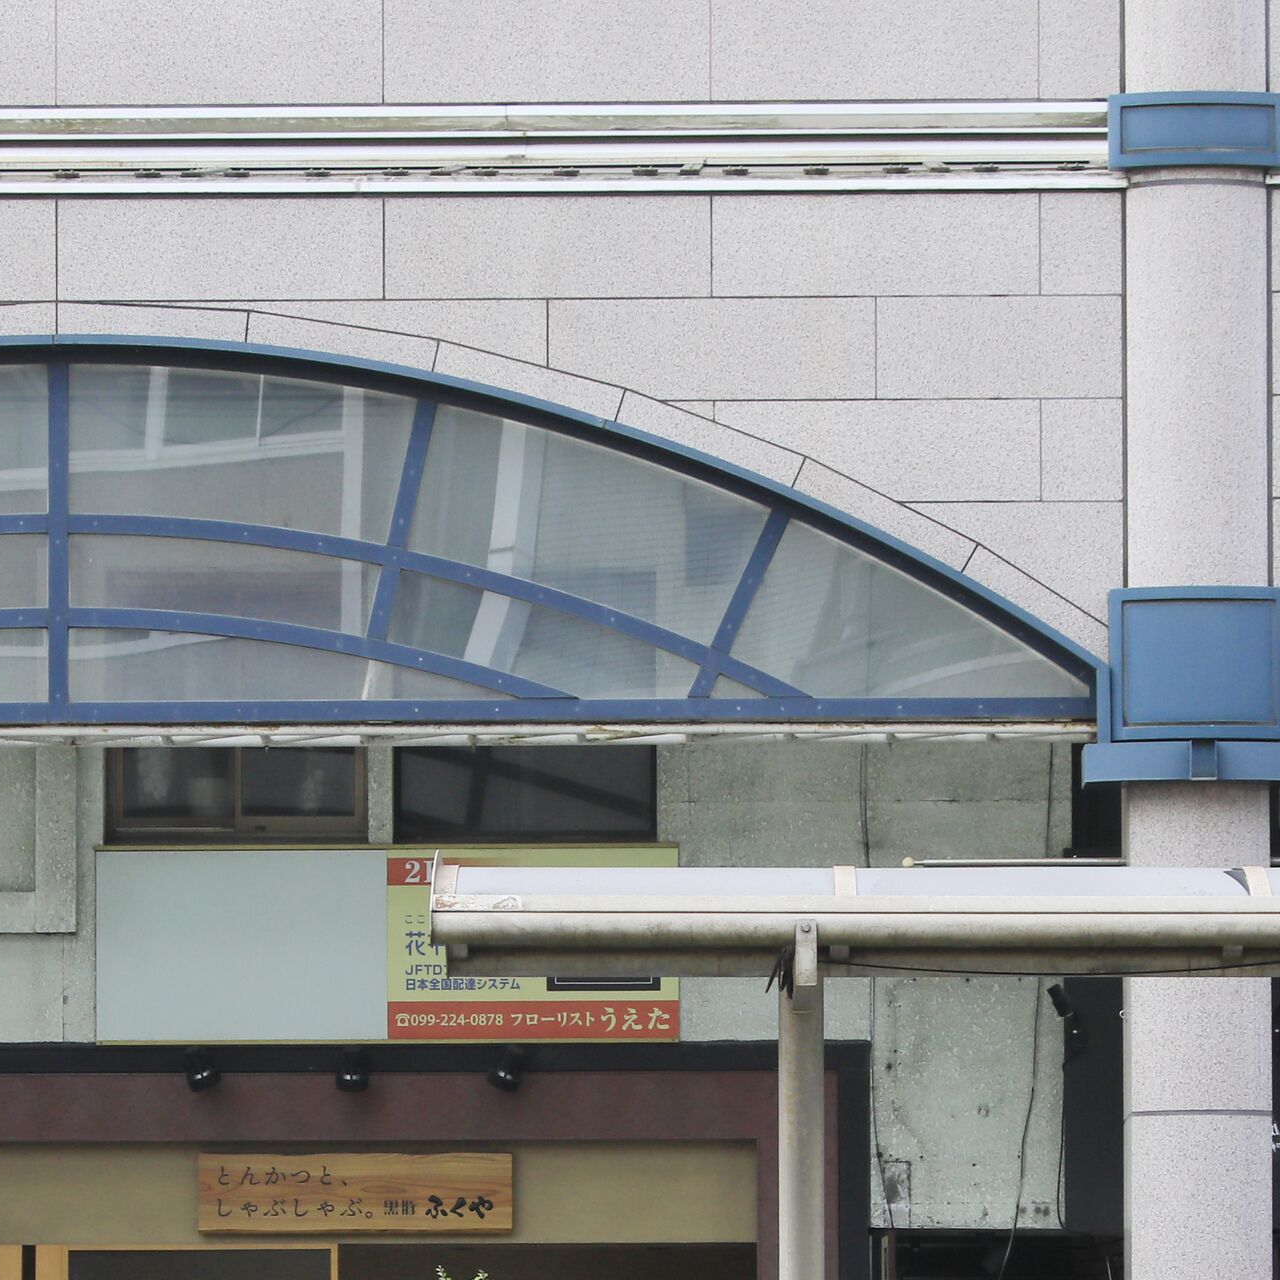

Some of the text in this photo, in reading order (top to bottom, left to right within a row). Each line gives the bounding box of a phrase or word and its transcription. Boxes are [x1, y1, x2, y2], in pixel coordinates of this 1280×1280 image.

[405, 964, 447, 976] JFTD
[406, 978, 520, 991] 日本全国配達システム
[411, 1007, 670, 1032] 099-224-0878 フローリスト うえた
